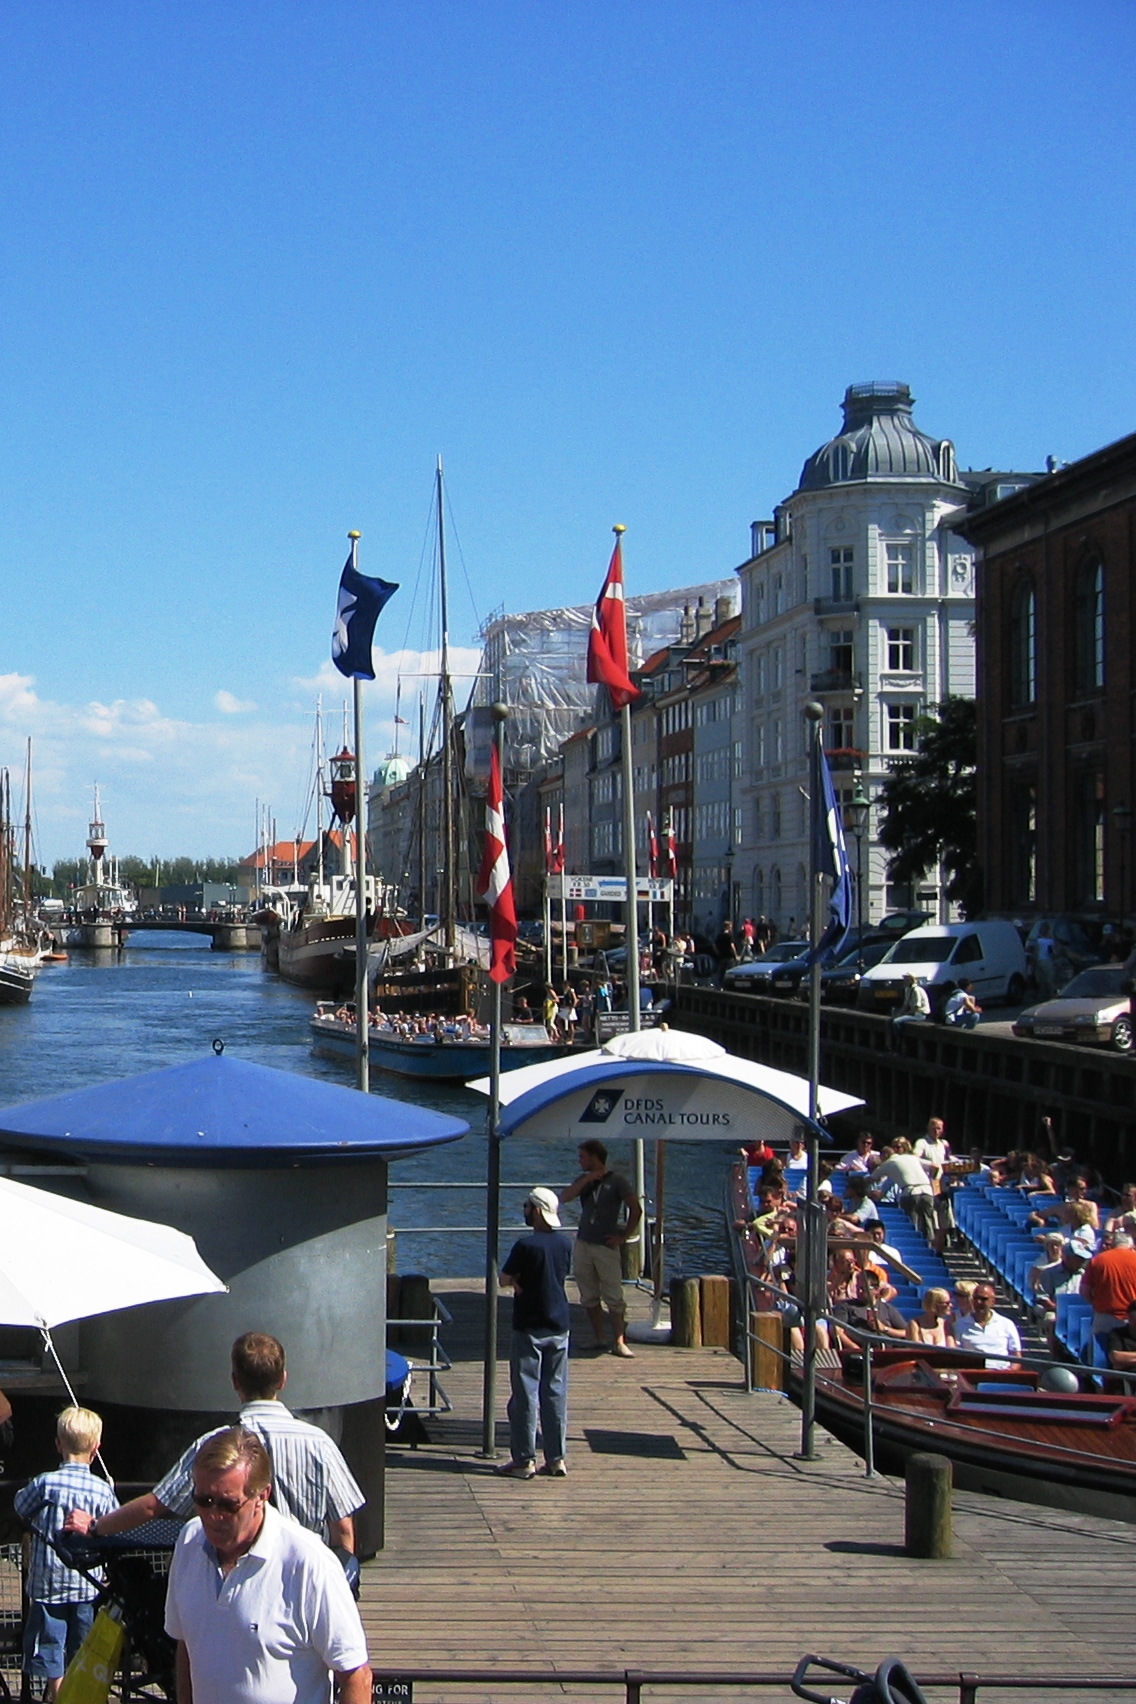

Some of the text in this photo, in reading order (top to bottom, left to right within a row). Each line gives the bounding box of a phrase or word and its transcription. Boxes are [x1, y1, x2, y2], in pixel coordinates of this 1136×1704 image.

[624, 1099, 664, 1111] DFDS
[624, 1112, 730, 1126] CANAL TOURS
[387, 1684, 409, 1696] FOR
